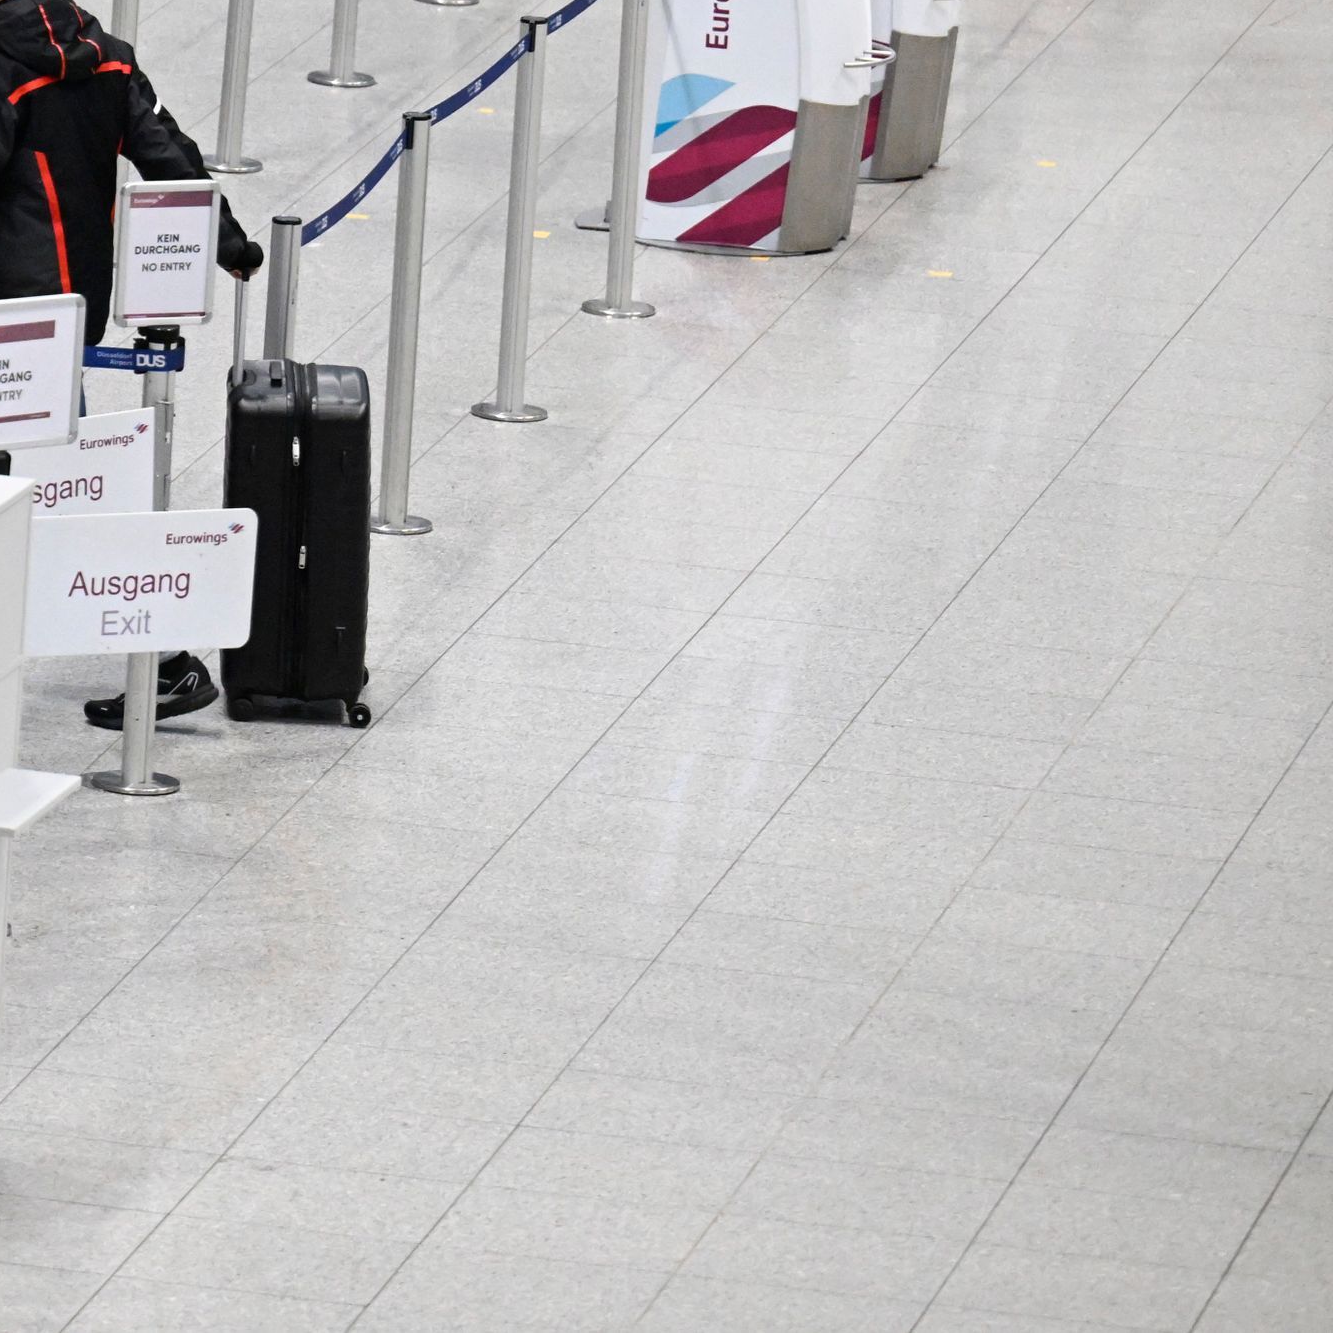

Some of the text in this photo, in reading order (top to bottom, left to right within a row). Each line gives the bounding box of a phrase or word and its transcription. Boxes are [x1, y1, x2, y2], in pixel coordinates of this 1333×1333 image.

[157, 234, 180, 243] KEIN
[134, 245, 201, 254] DURCHGANG
[142, 262, 191, 272] NO ENTRY
[137, 354, 165, 367] DUS
[79, 432, 135, 451] Eurowings
[166, 531, 228, 547] Eurowings
[68, 569, 191, 601] Ausgang
[100, 610, 152, 636] Exit
